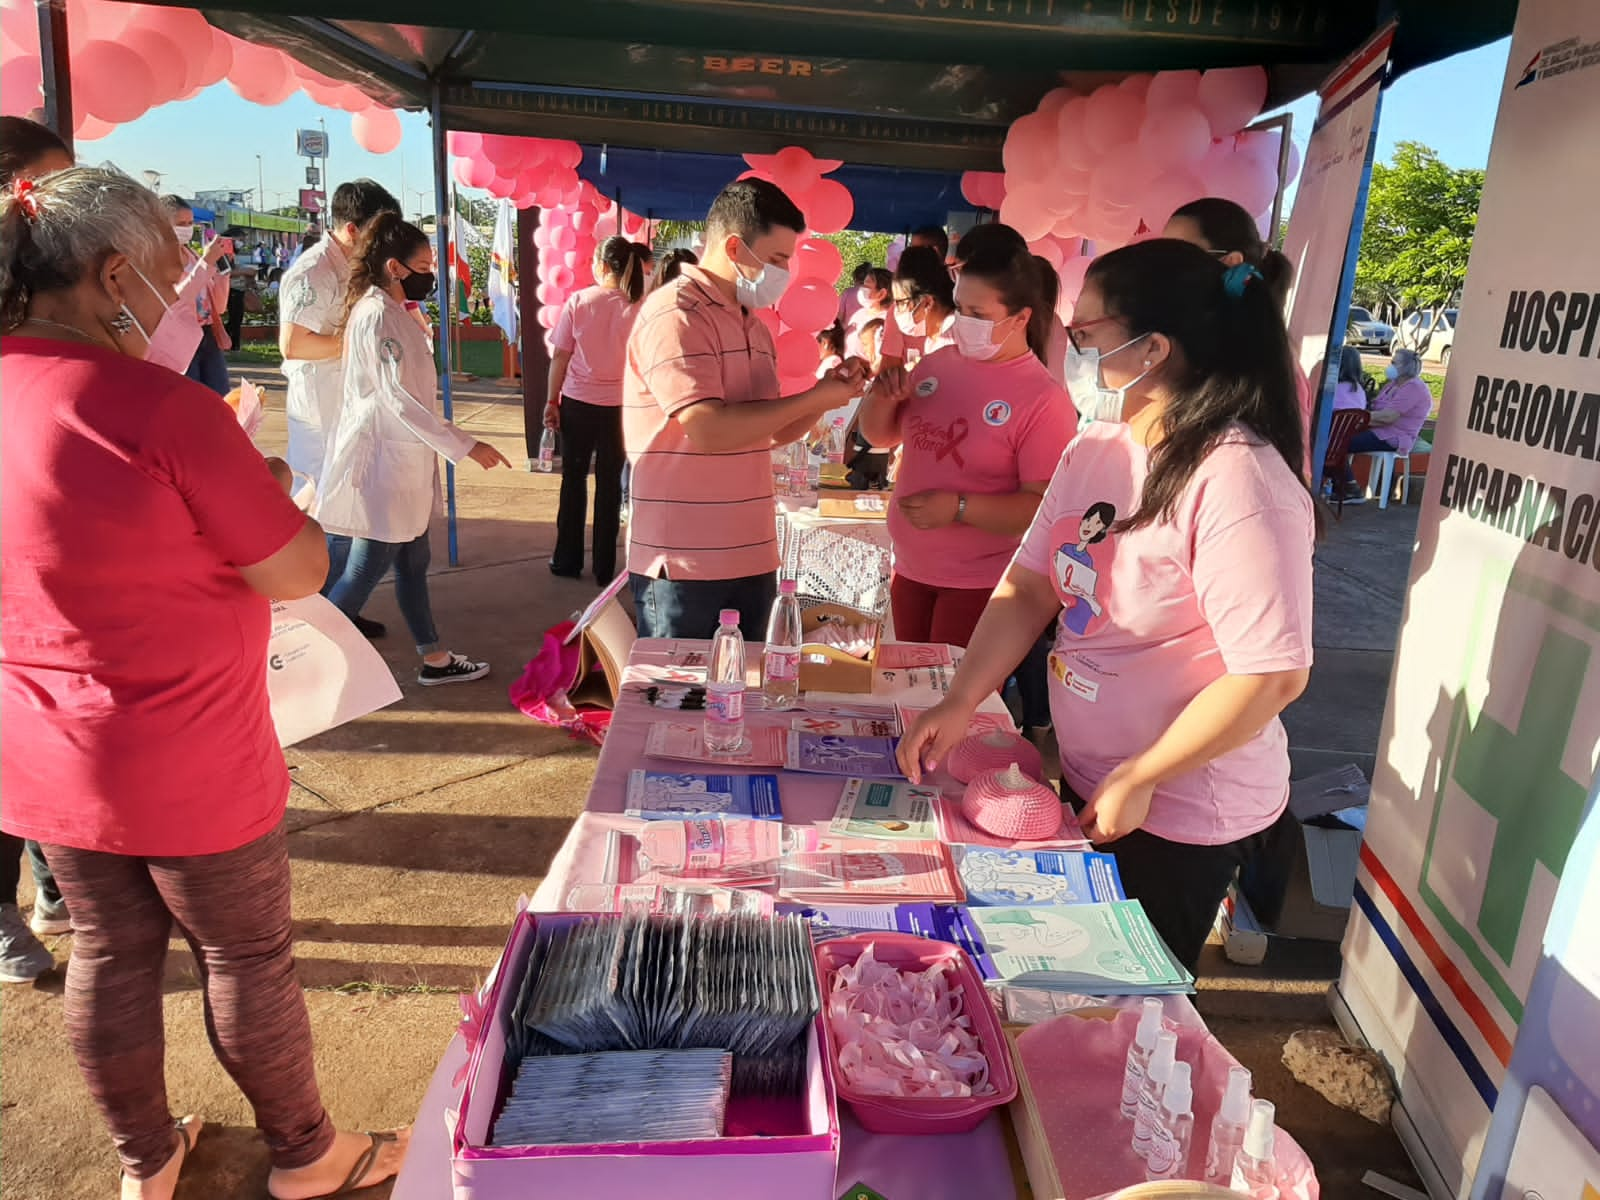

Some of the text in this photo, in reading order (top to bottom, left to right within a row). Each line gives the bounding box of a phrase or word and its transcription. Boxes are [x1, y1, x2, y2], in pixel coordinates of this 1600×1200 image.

[703, 56, 812, 77] BEER
[1500, 291, 1600, 359] HOSPI
[1467, 375, 1600, 462] REGIONA
